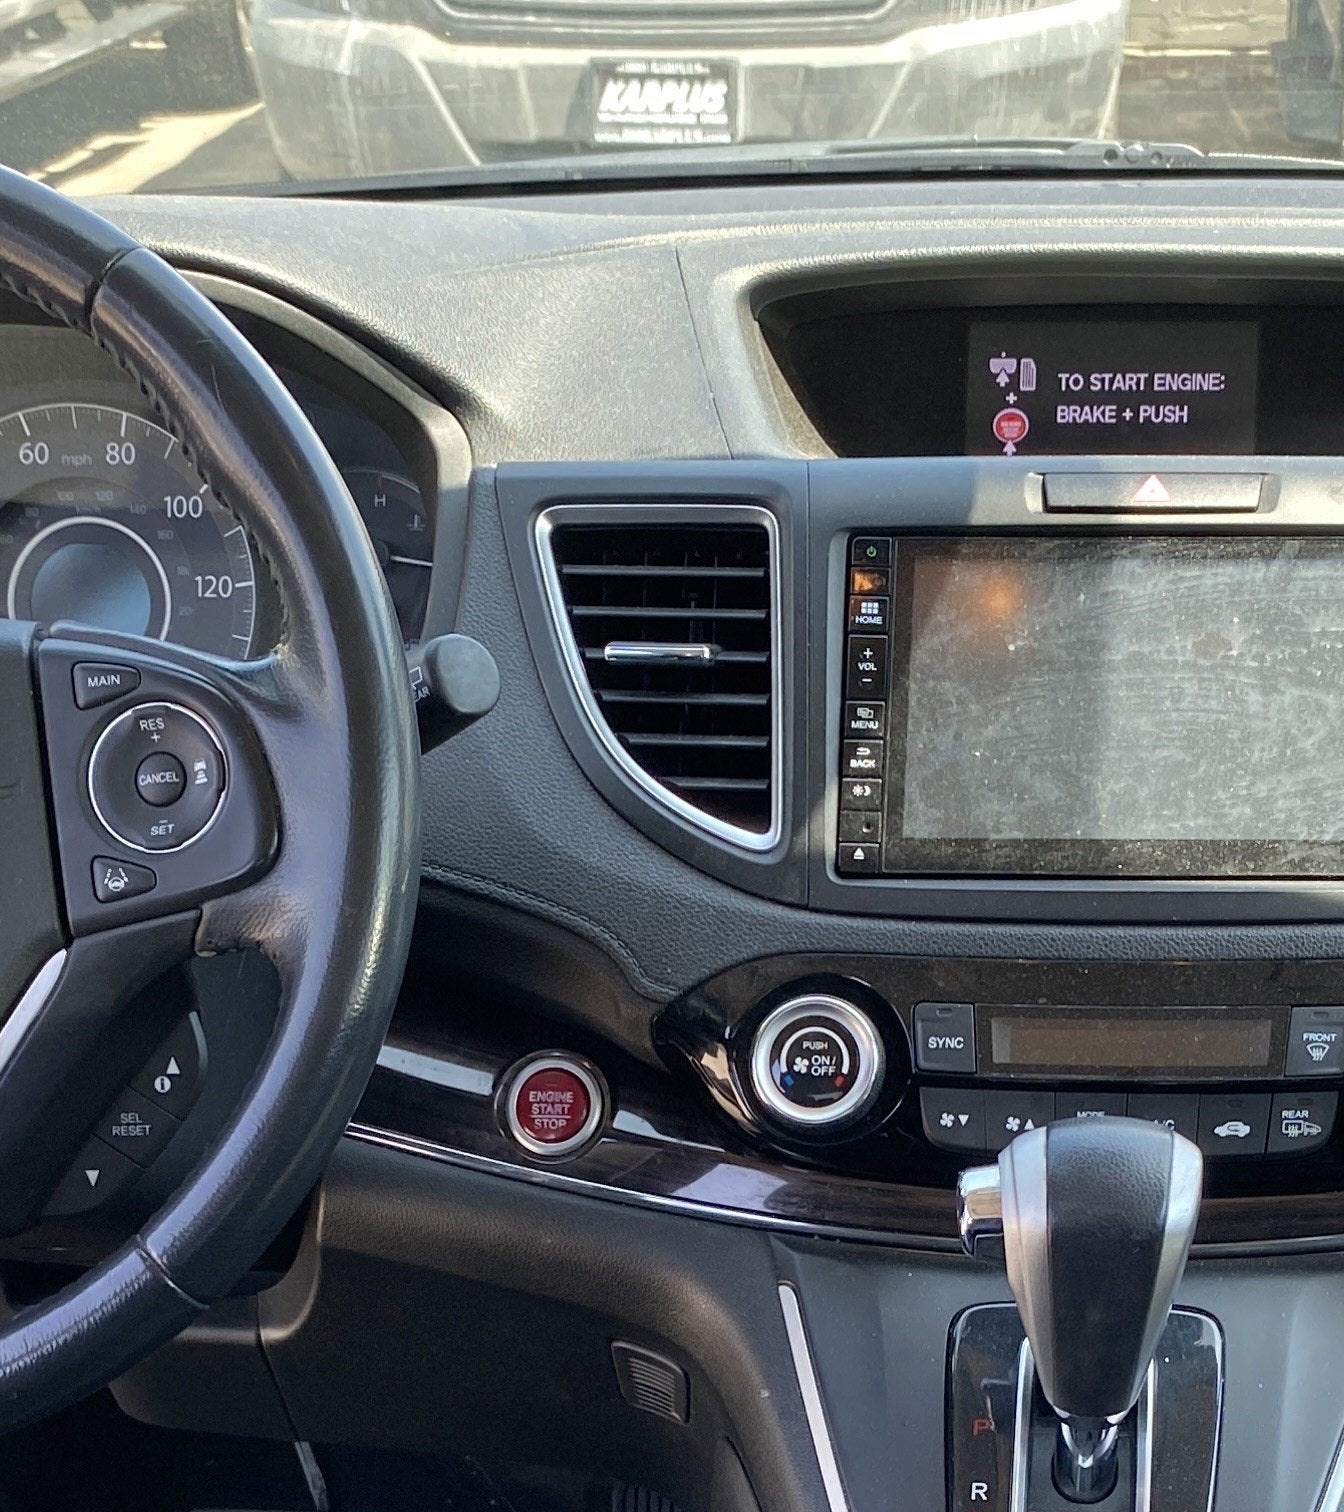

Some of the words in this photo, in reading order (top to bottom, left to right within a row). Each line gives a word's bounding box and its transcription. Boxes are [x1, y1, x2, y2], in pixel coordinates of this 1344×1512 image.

[598, 77, 728, 113] KARPLUS
[1057, 373, 1084, 391] TO
[1090, 373, 1149, 391] START
[1154, 373, 1225, 391] ENGINE:
[1056, 405, 1117, 423] BRAKE
[1139, 405, 1188, 423] PUSH
[19, 443, 49, 465] 60
[61, 453, 92, 467] mph
[106, 443, 136, 465] 80
[164, 496, 203, 518] 100
[374, 494, 386, 507] H
[194, 575, 233, 598] 120
[855, 615, 882, 624] HOME
[858, 662, 877, 671] VOL
[87, 675, 120, 688] MAIN
[413, 686, 431, 703] EAR
[139, 718, 165, 732] RES
[851, 720, 878, 729] MENU
[850, 759, 875, 768] BACK
[139, 771, 180, 786] CANCEL
[150, 823, 175, 836] SET
[928, 1037, 964, 1050] SYNC
[1303, 1032, 1336, 1042] FRONT
[802, 1040, 828, 1050] PUSH
[811, 1066, 837, 1077] OFF
[529, 1091, 574, 1103] ENGINE
[531, 1103, 570, 1115] START
[1282, 1110, 1309, 1119] REAR
[120, 1112, 143, 1124] SEL
[534, 1119, 567, 1130] STOP
[112, 1125, 151, 1136] RESET
[973, 1419, 990, 1435] P
[971, 1482, 988, 1500] R
